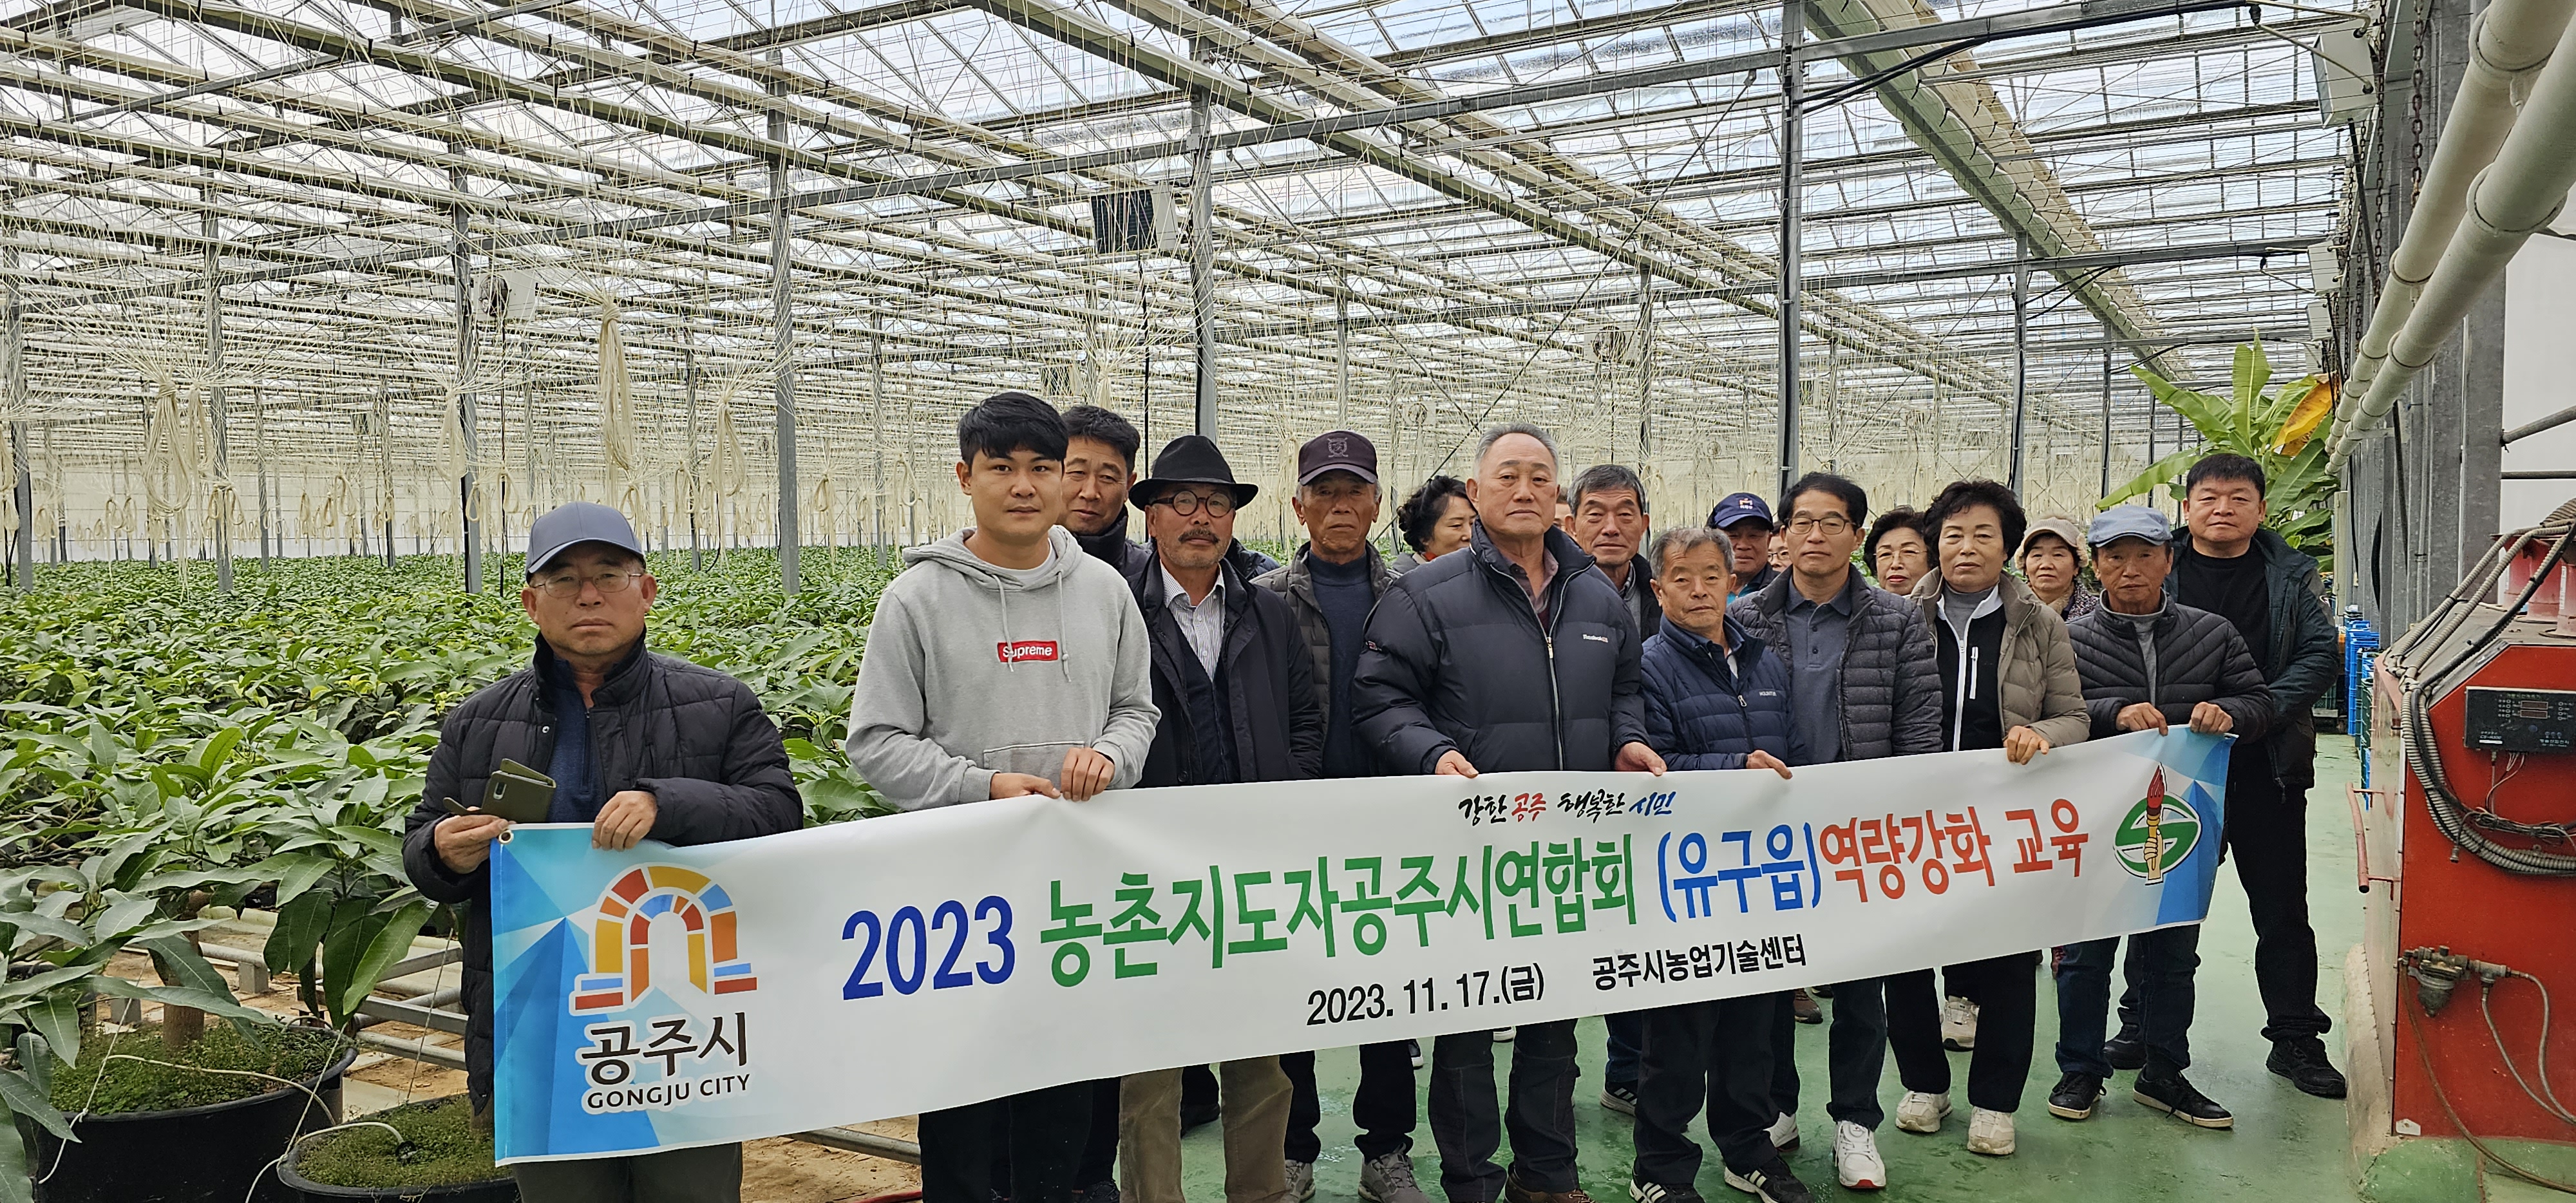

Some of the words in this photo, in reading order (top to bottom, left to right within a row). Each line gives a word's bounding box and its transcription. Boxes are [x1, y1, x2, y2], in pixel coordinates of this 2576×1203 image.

[1003, 646, 1053, 659] Supreme
[1458, 794, 1508, 826] 강한
[1511, 793, 1546, 822] 공주
[1557, 788, 1626, 824] 행복한
[1629, 791, 1676, 817] 시민
[842, 895, 1016, 1001] 2023
[1040, 834, 1637, 987] 농촌지도자공주시연합회
[2005, 799, 2089, 877] 교육
[1306, 983, 1394, 1025] 2023.
[1403, 978, 1448, 1014] 11.
[1593, 933, 1808, 992] 공주시농업기술센터
[580, 1012, 749, 1085] 공주시
[587, 1081, 690, 1110] GONGJU
[700, 1074, 750, 1097] CITY
